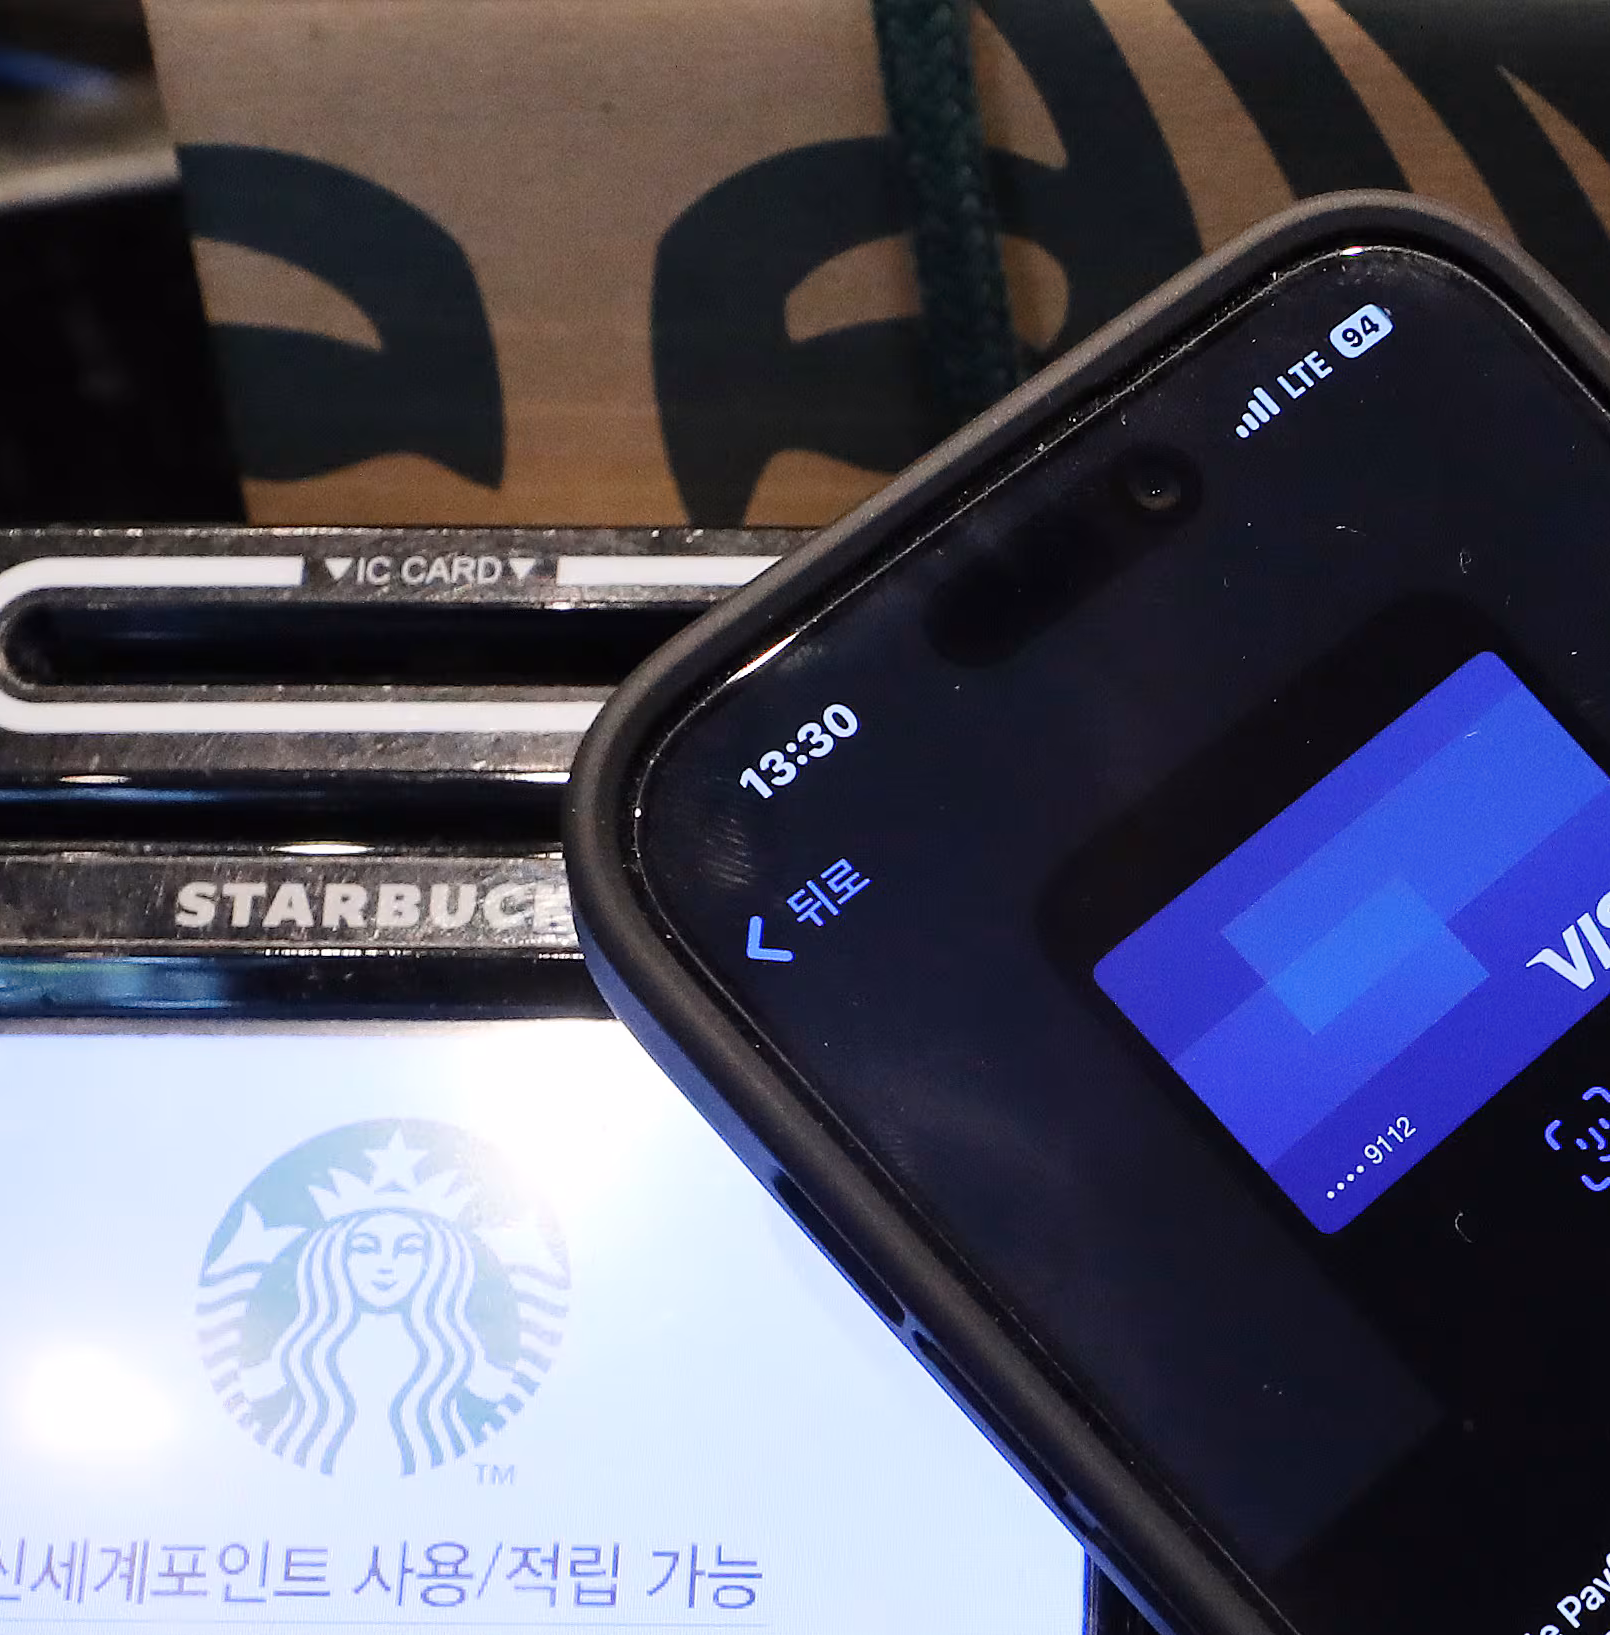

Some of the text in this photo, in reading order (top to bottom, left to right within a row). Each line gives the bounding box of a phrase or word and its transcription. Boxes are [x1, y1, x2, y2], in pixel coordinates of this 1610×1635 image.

[1278, 313, 1383, 402] LTE 94
[356, 555, 503, 586] IC CARD
[737, 703, 861, 798] 13:30
[175, 880, 576, 935] STARBUCK
[786, 857, 872, 927] 뒤로
[1364, 1115, 1417, 1166] 9112
[353, 1541, 621, 1608] 사용/적립
[648, 1542, 763, 1610] 가능
